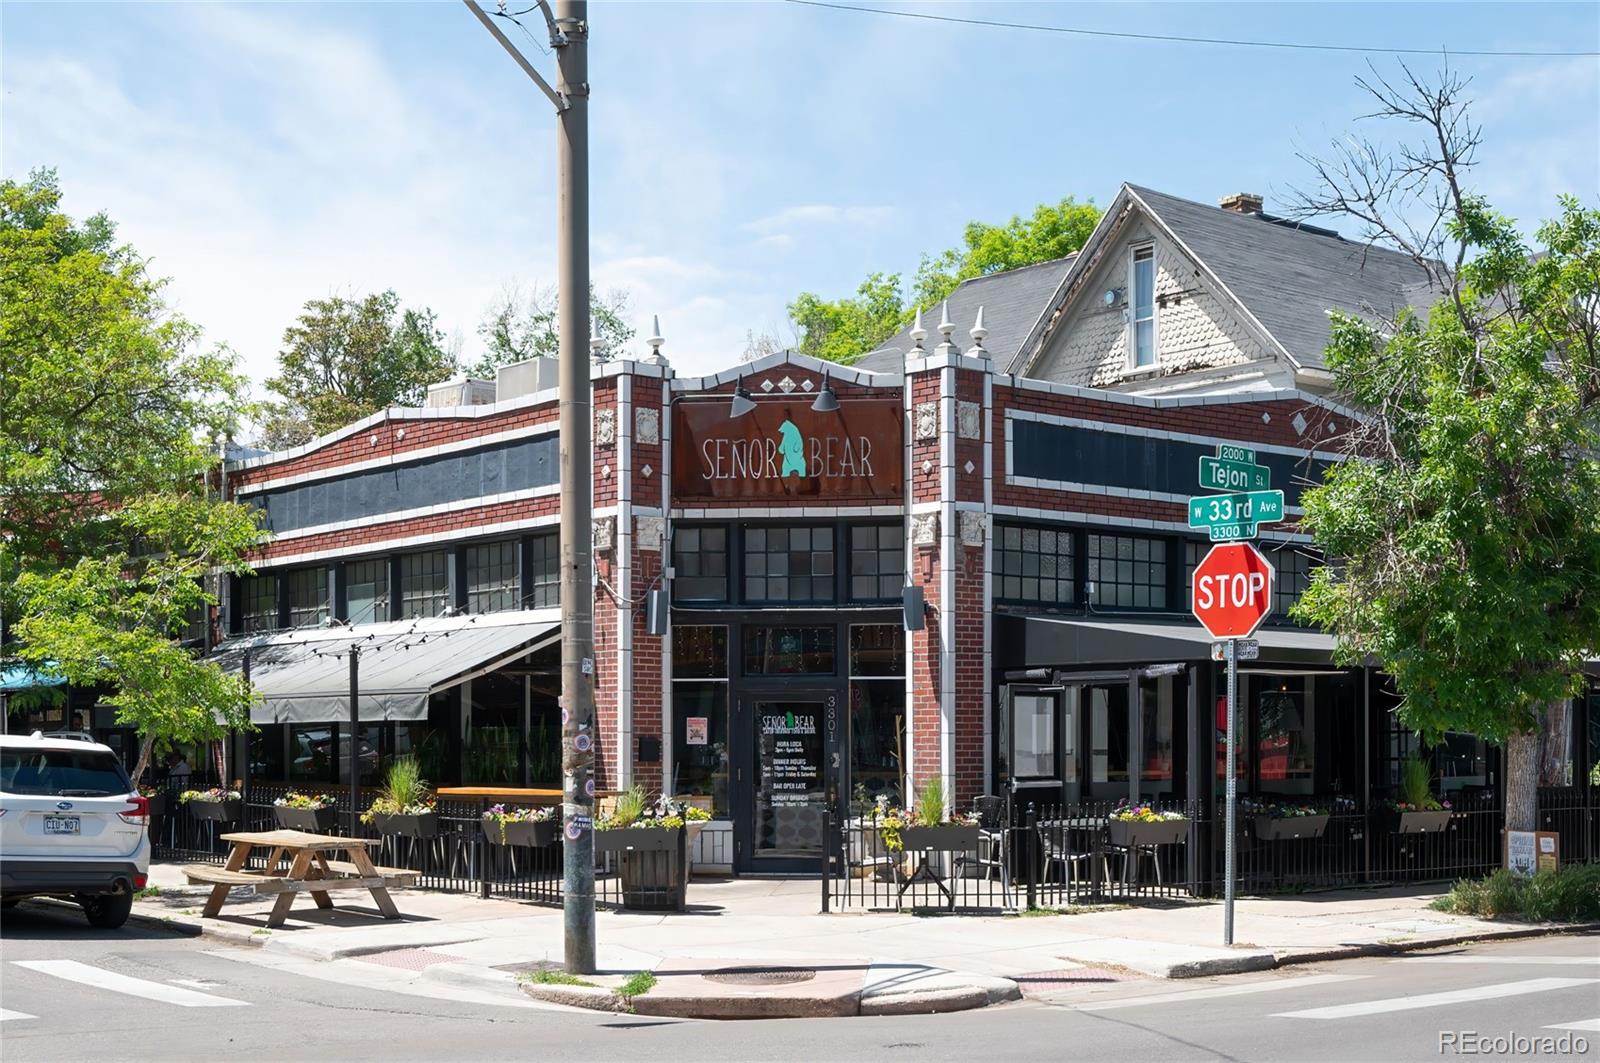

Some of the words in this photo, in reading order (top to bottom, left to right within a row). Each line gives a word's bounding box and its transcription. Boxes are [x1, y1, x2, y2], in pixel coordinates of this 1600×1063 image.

[702, 438, 779, 480] SEÑOR
[808, 436, 875, 478] BEAR
[1222, 447, 1244, 461] 2000
[1247, 451, 1253, 463] W
[1208, 462, 1248, 489] Tejon
[1255, 475, 1264, 487] St
[1194, 506, 1202, 518] W
[1208, 498, 1252, 522] 33rd
[1260, 500, 1277, 513] Ave
[1213, 525, 1240, 539] 3300
[1246, 524, 1254, 536] N
[1198, 572, 1265, 610] STOP
[794, 715, 815, 729] BEAR
[828, 696, 836, 742] 3301
